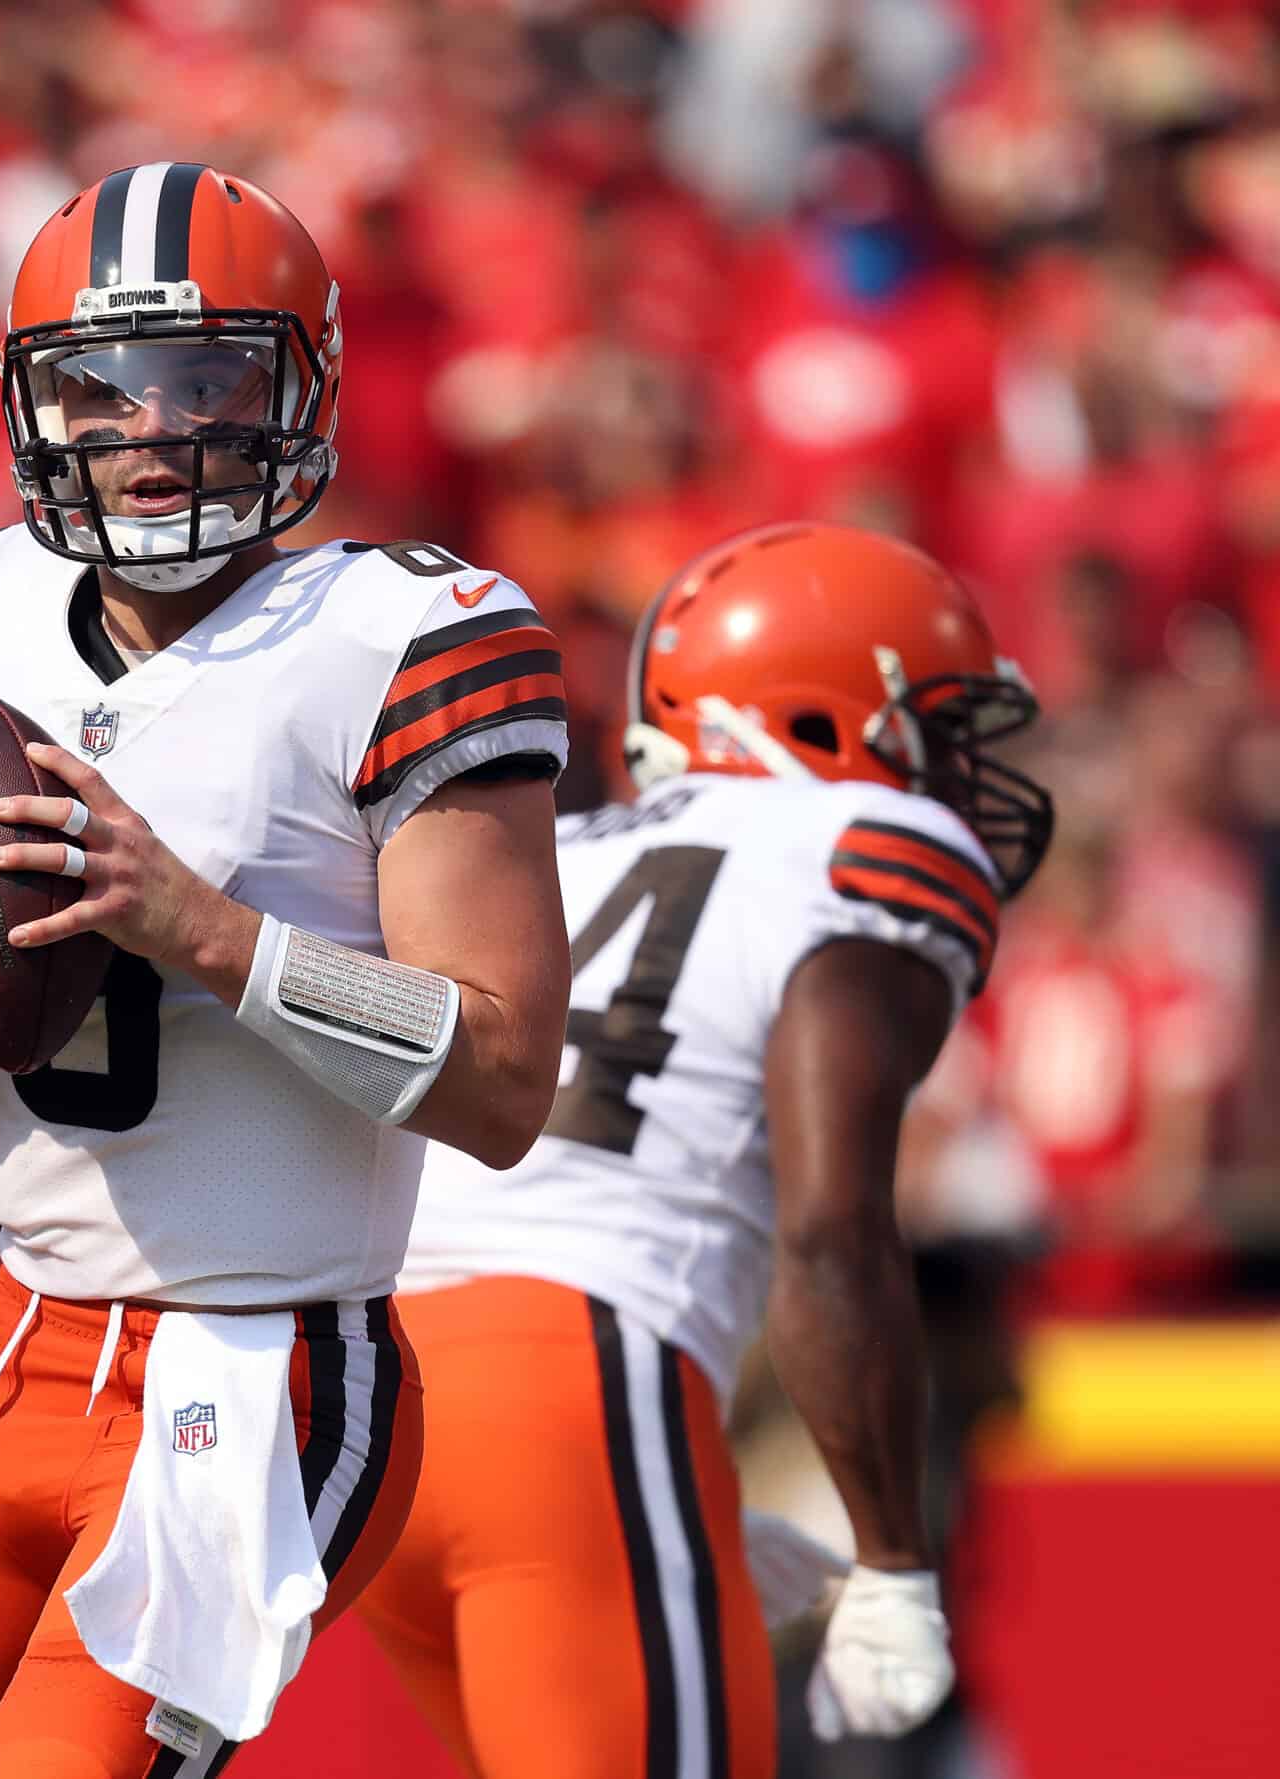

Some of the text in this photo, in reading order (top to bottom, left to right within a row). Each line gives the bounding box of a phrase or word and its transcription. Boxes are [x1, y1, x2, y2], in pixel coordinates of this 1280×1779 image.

[108, 289, 167, 308] BROWNS
[83, 727, 108, 749] NFL
[177, 1424, 213, 1451] NFL
